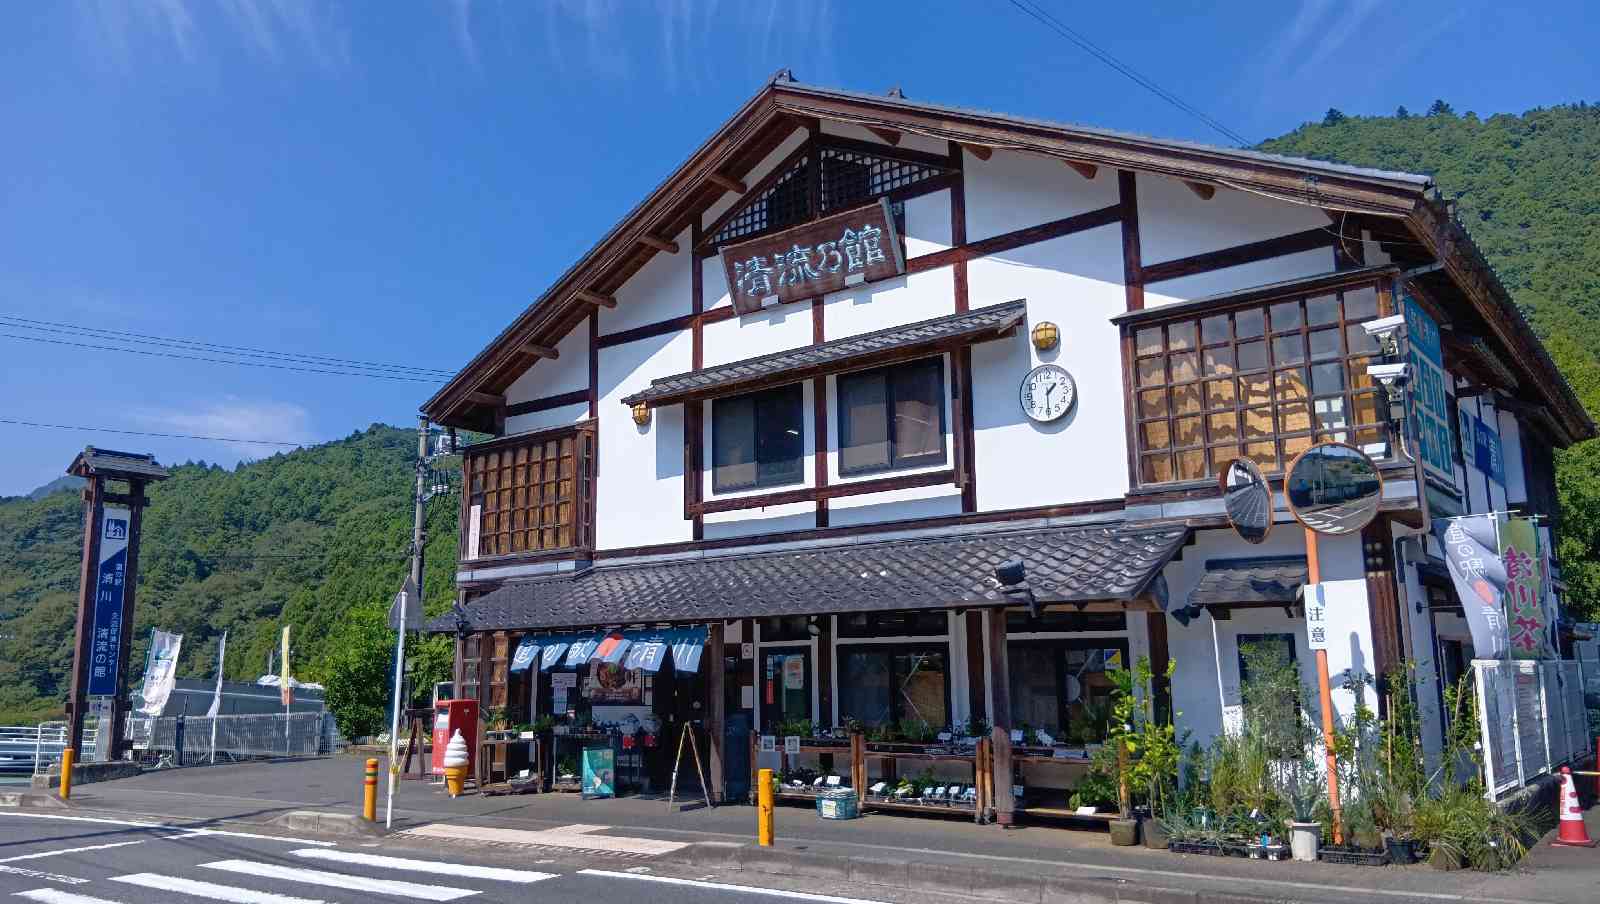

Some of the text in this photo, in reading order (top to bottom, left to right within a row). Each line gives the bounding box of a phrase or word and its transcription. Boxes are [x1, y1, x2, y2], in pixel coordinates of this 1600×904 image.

[734, 224, 886, 297] 清流乃館
[1309, 606, 1326, 643] 注意
